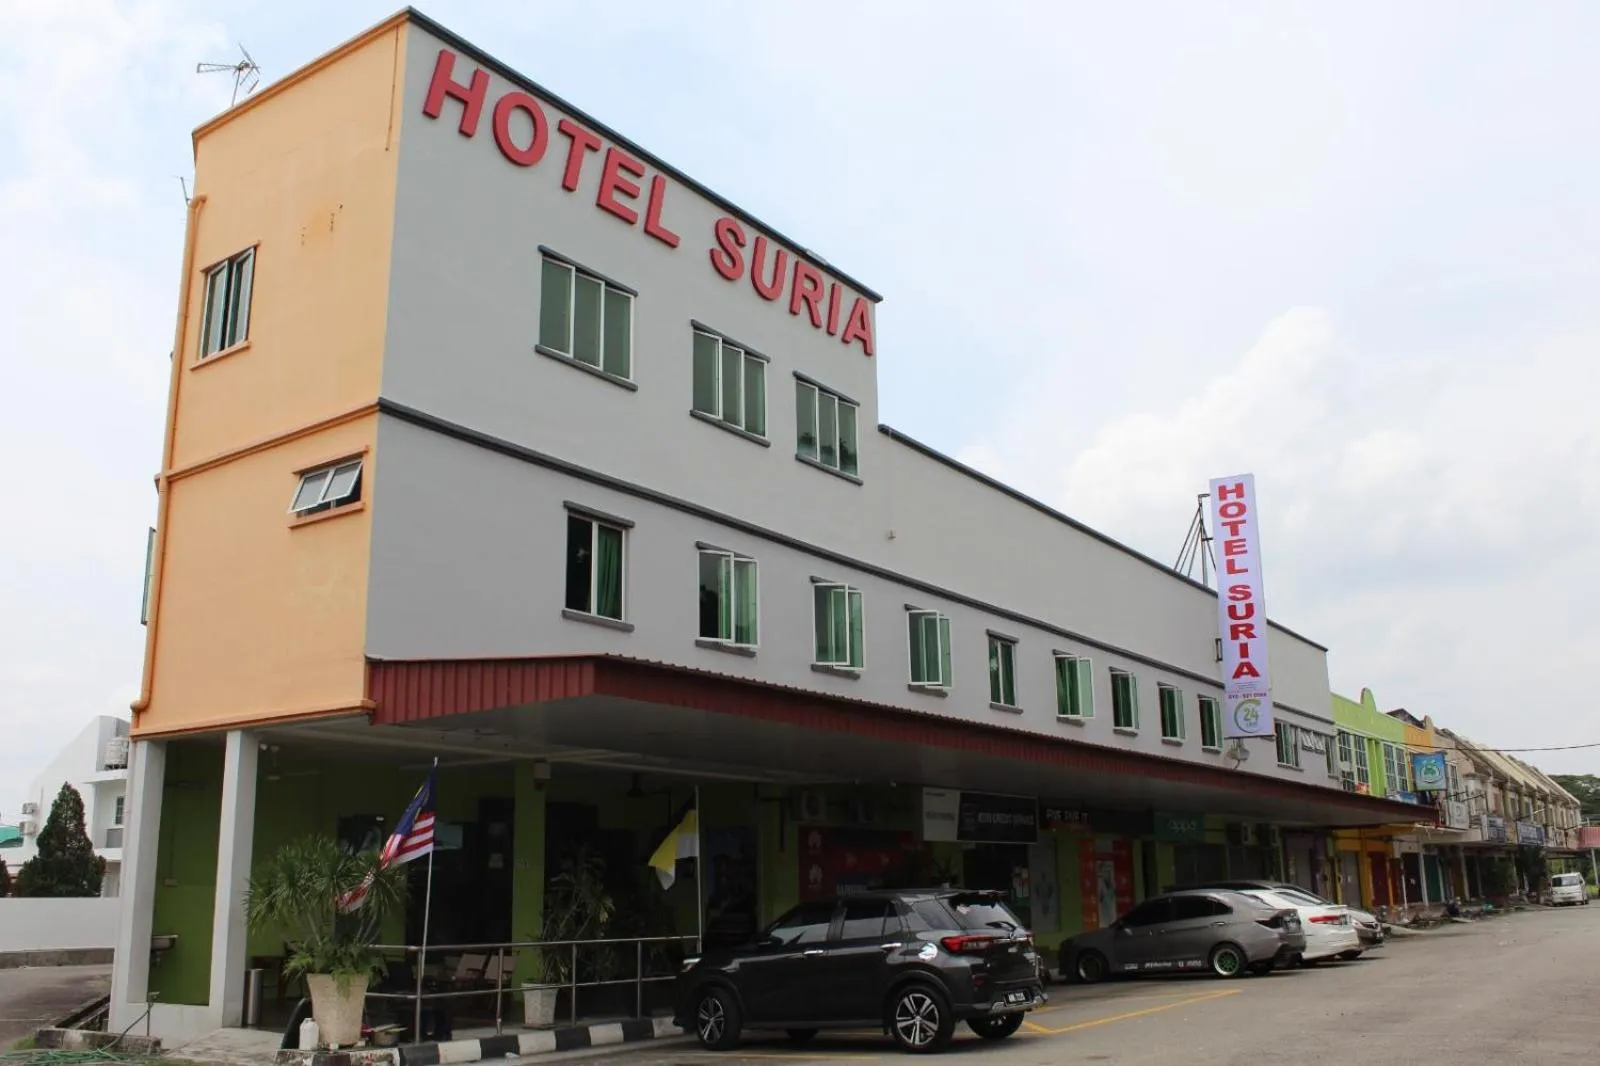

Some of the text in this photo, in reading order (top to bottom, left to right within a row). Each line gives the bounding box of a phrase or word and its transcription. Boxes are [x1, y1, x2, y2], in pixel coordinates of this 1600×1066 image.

[422, 49, 874, 357] HOTEL SURIA
[1217, 483, 1248, 575] HOTEL
[1227, 584, 1260, 680] SURIA
